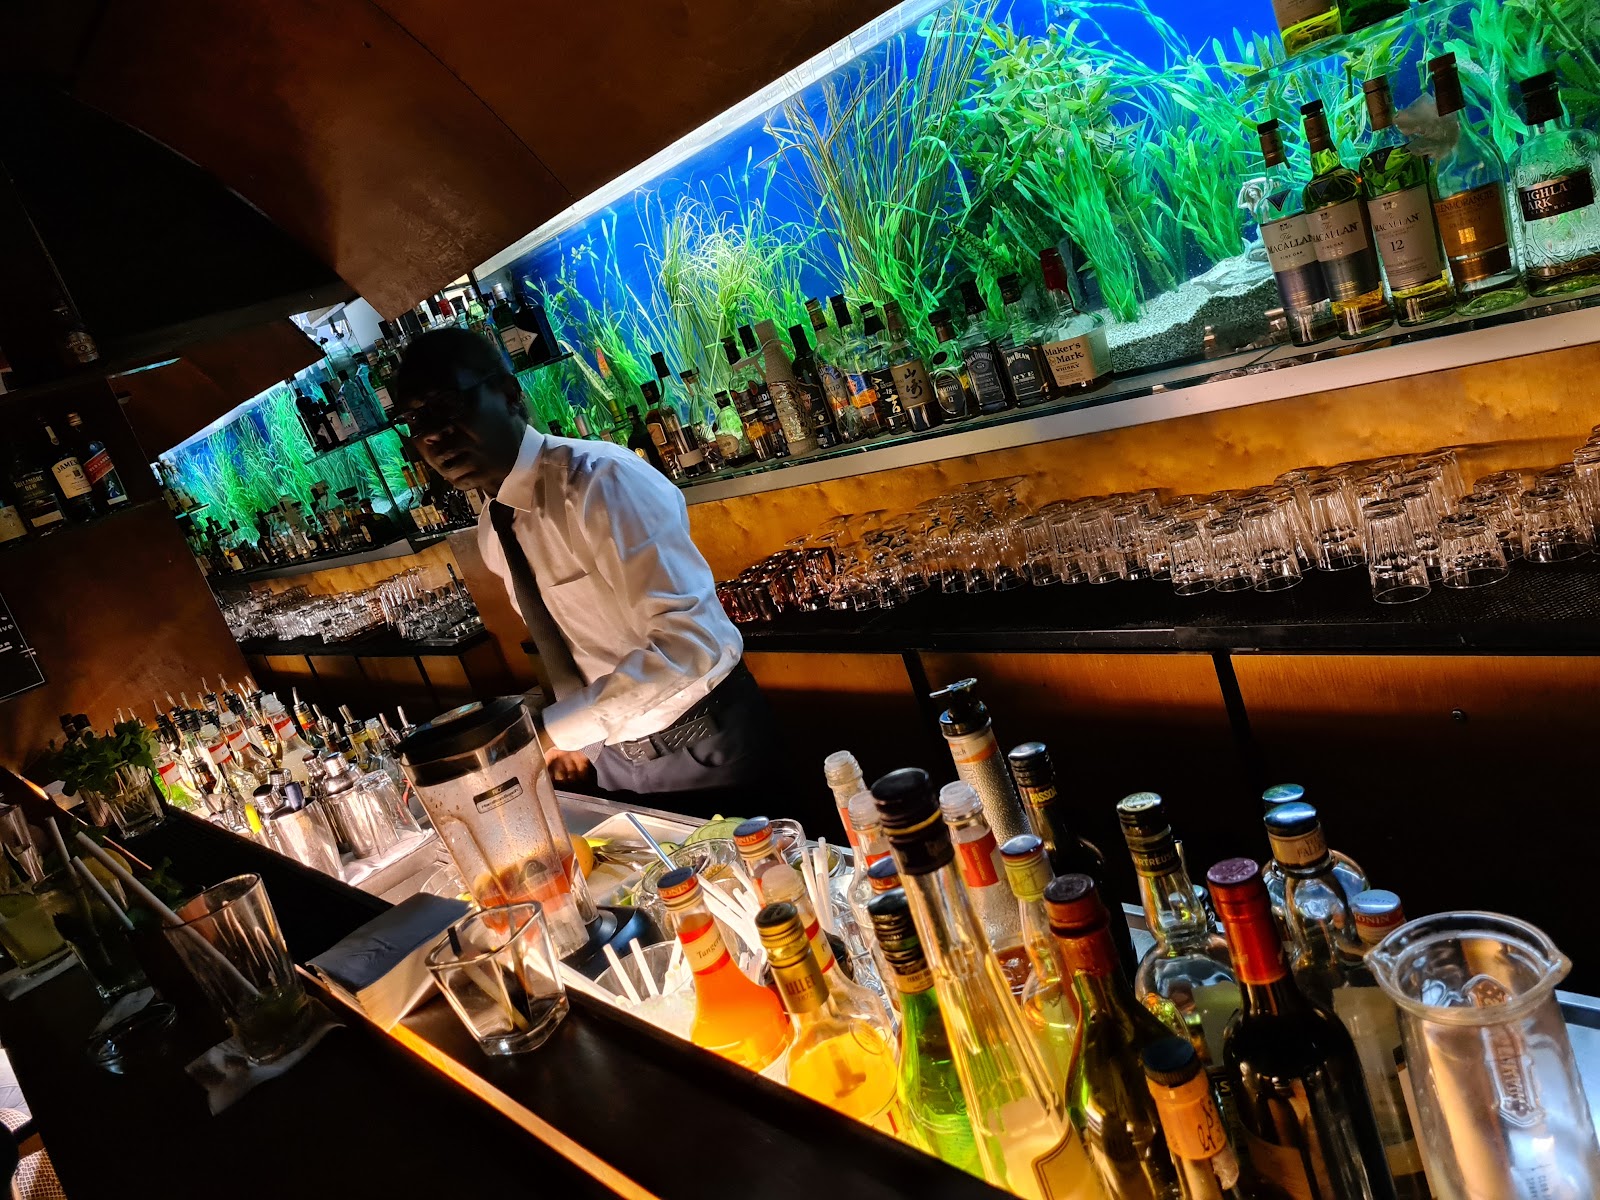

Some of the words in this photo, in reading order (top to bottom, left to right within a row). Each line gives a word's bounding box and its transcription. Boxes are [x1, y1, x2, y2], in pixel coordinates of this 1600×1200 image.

[1524, 183, 1568, 200] IGHLA
[1527, 197, 1552, 211] ARK
[1390, 239, 1405, 252] 12
[1044, 342, 1081, 357] Maker's
[1056, 351, 1084, 364] Mark
[1012, 370, 1035, 380] RYE
[57, 459, 79, 474] JAMES
